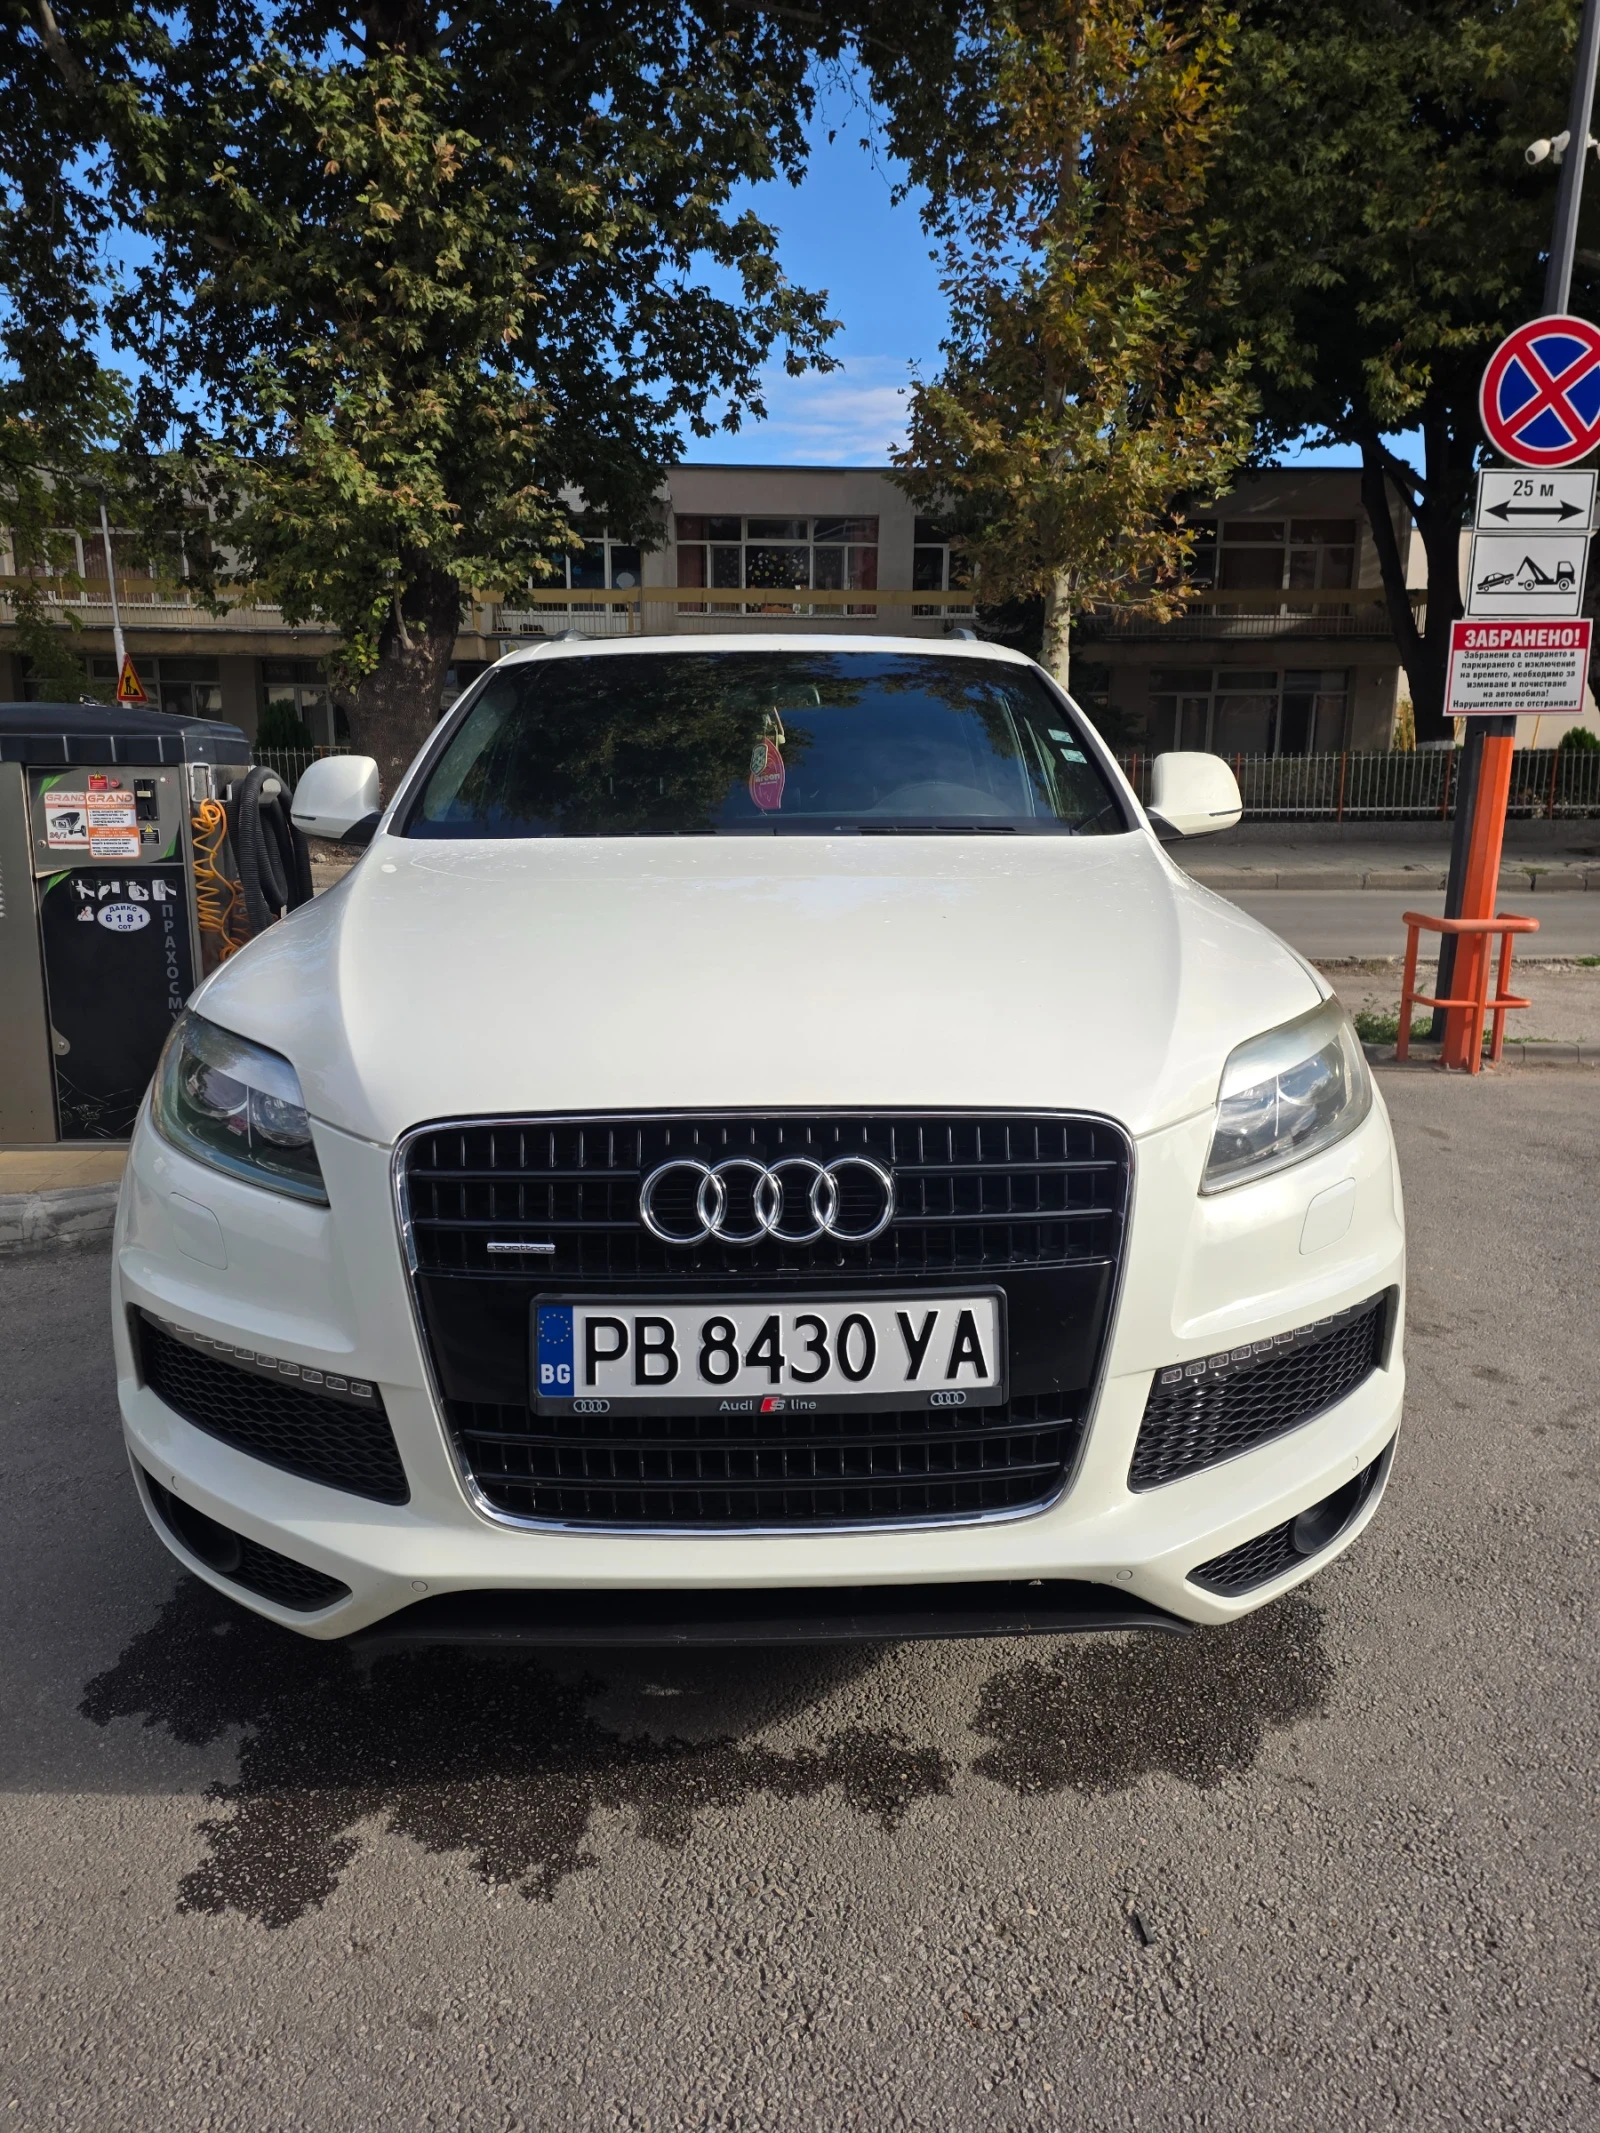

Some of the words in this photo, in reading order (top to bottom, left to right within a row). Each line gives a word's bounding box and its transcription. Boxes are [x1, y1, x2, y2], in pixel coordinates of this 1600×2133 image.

[1513, 479, 1534, 497] 25
[1464, 628, 1580, 648] ЗАБРАНЕНО!
[1464, 651, 1509, 660] Забранени
[1524, 651, 1567, 660] спирането
[1462, 661, 1515, 671] паркирането
[1525, 660, 1576, 669] изключение
[1473, 671, 1510, 680] времето,
[1513, 670, 1564, 679] необходимо
[1495, 689, 1549, 698] автомобила!
[1453, 700, 1513, 709] Нарушителите
[1527, 699, 1577, 708] отстраняват
[755, 773, 780, 782] areon
[46, 794, 86, 802] GRAND
[87, 794, 133, 803] GRAND
[488, 1244, 555, 1253] quattro
[584, 1315, 679, 1386] PB
[698, 1312, 877, 1384] 8430
[541, 1363, 571, 1384] BG
[719, 1399, 753, 1411] Audi
[791, 1399, 816, 1411] line
